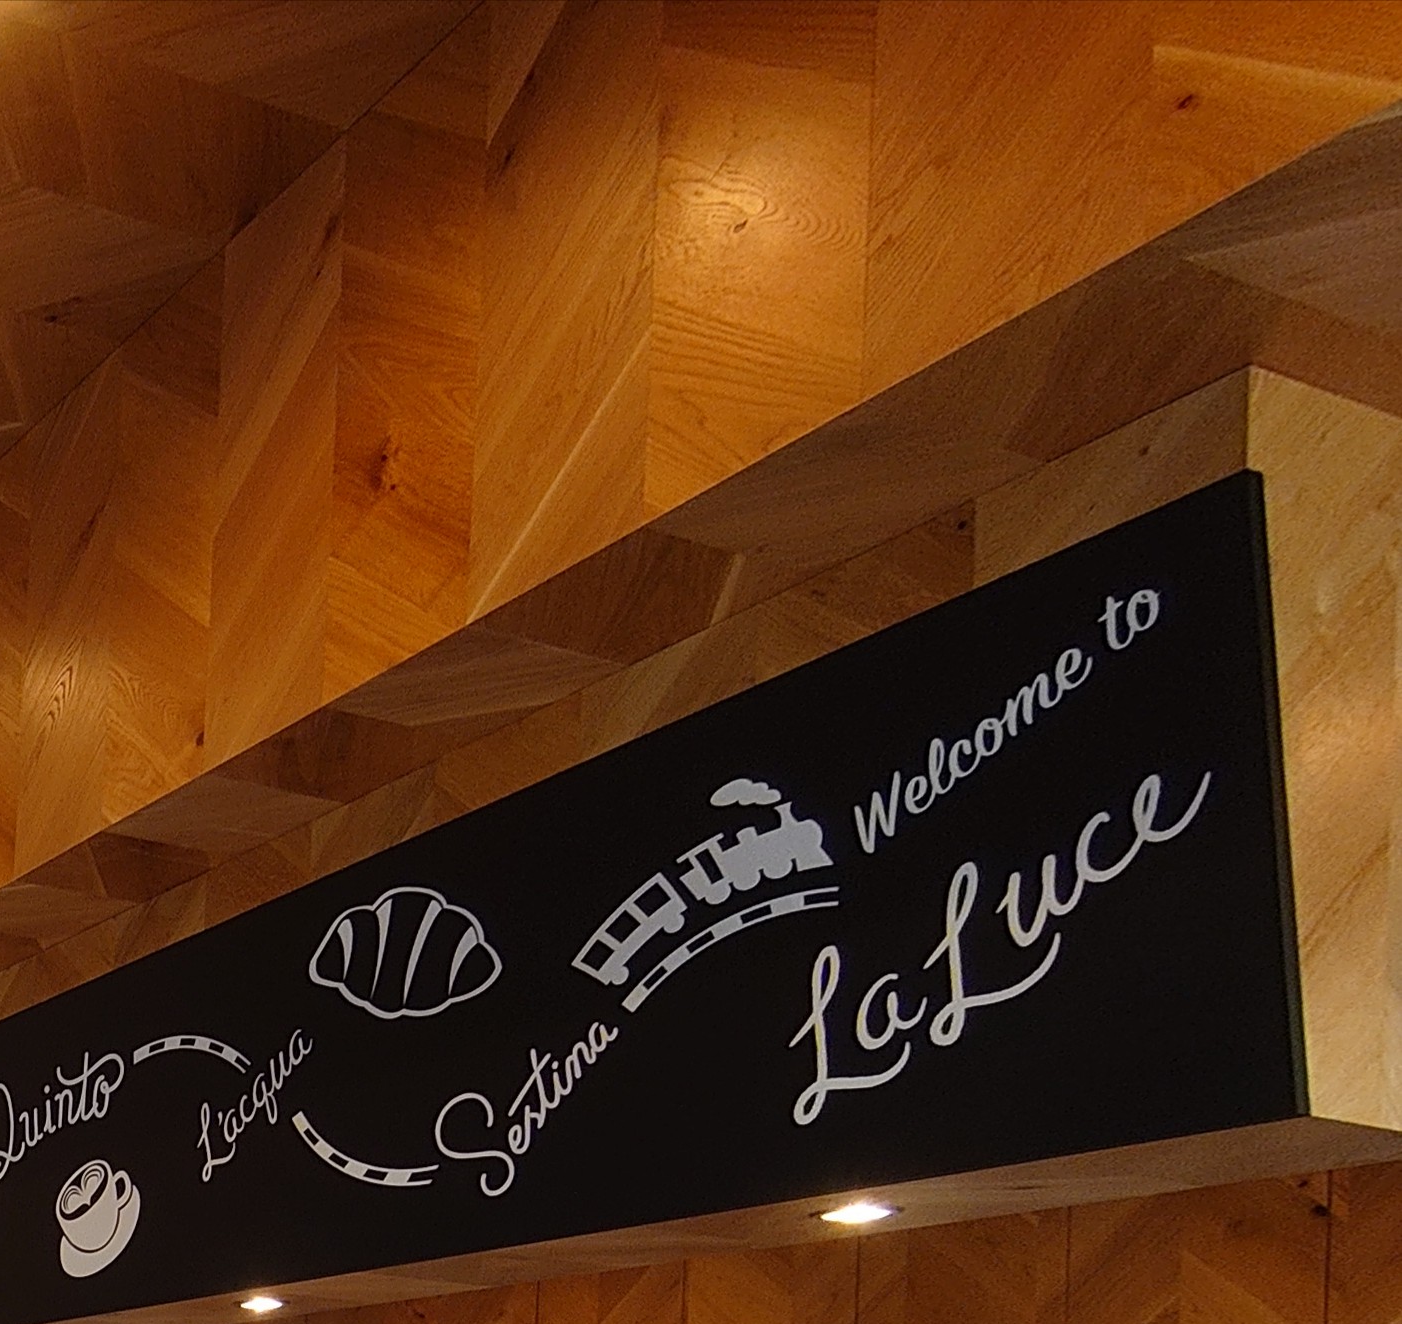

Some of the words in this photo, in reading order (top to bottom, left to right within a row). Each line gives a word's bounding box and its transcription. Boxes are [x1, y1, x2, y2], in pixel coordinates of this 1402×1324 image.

[855, 648, 1093, 853] Welcome
[1098, 589, 1159, 650] to
[791, 946, 928, 1126] La
[922, 771, 1211, 1047] Luce
[197, 1029, 313, 1182] L'acqua
[436, 1022, 619, 1197] Sestina
